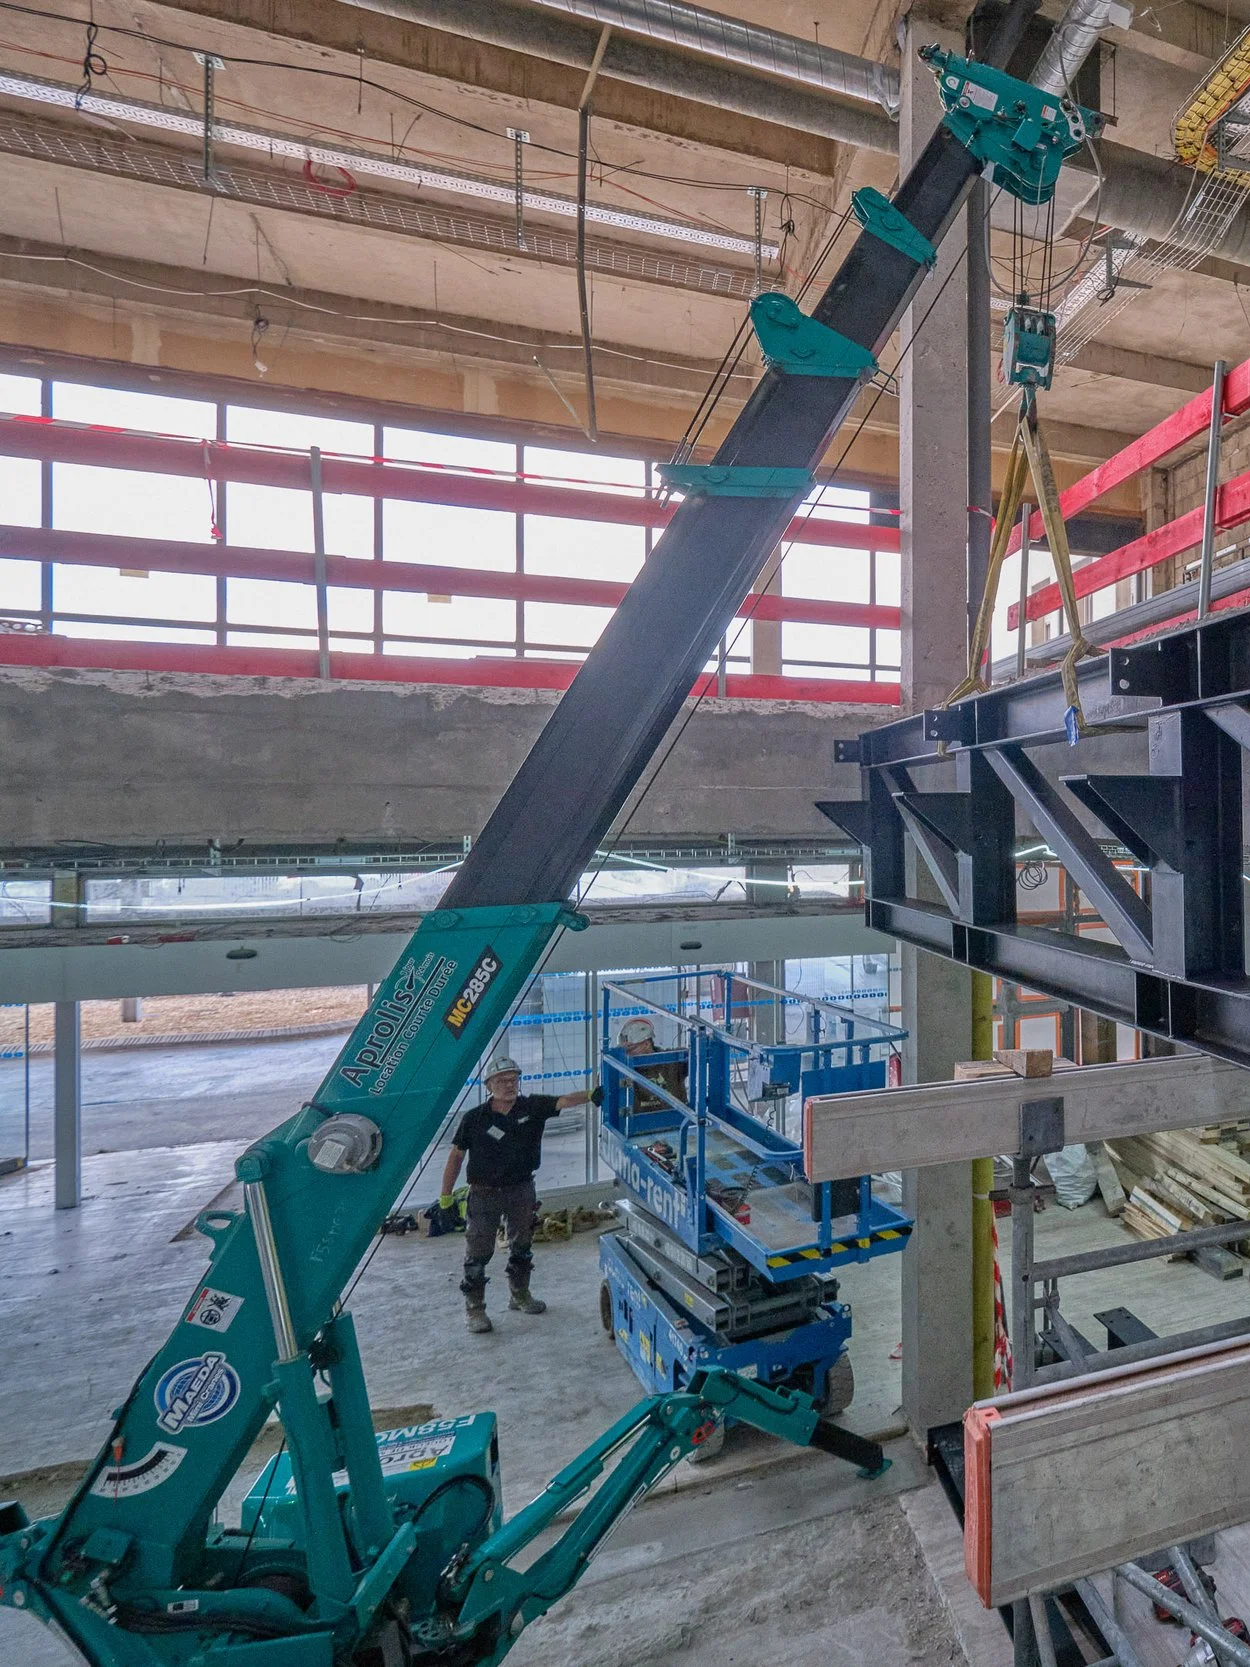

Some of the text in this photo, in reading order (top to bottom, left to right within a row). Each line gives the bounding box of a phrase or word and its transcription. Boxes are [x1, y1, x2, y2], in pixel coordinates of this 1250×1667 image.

[368, 960, 458, 1096] Location Courte Durée
[447, 957, 498, 1028] MC285C
[339, 987, 417, 1088] Aprolis
[163, 1356, 220, 1431] MAEDA
[201, 1368, 224, 1400] Cranes
